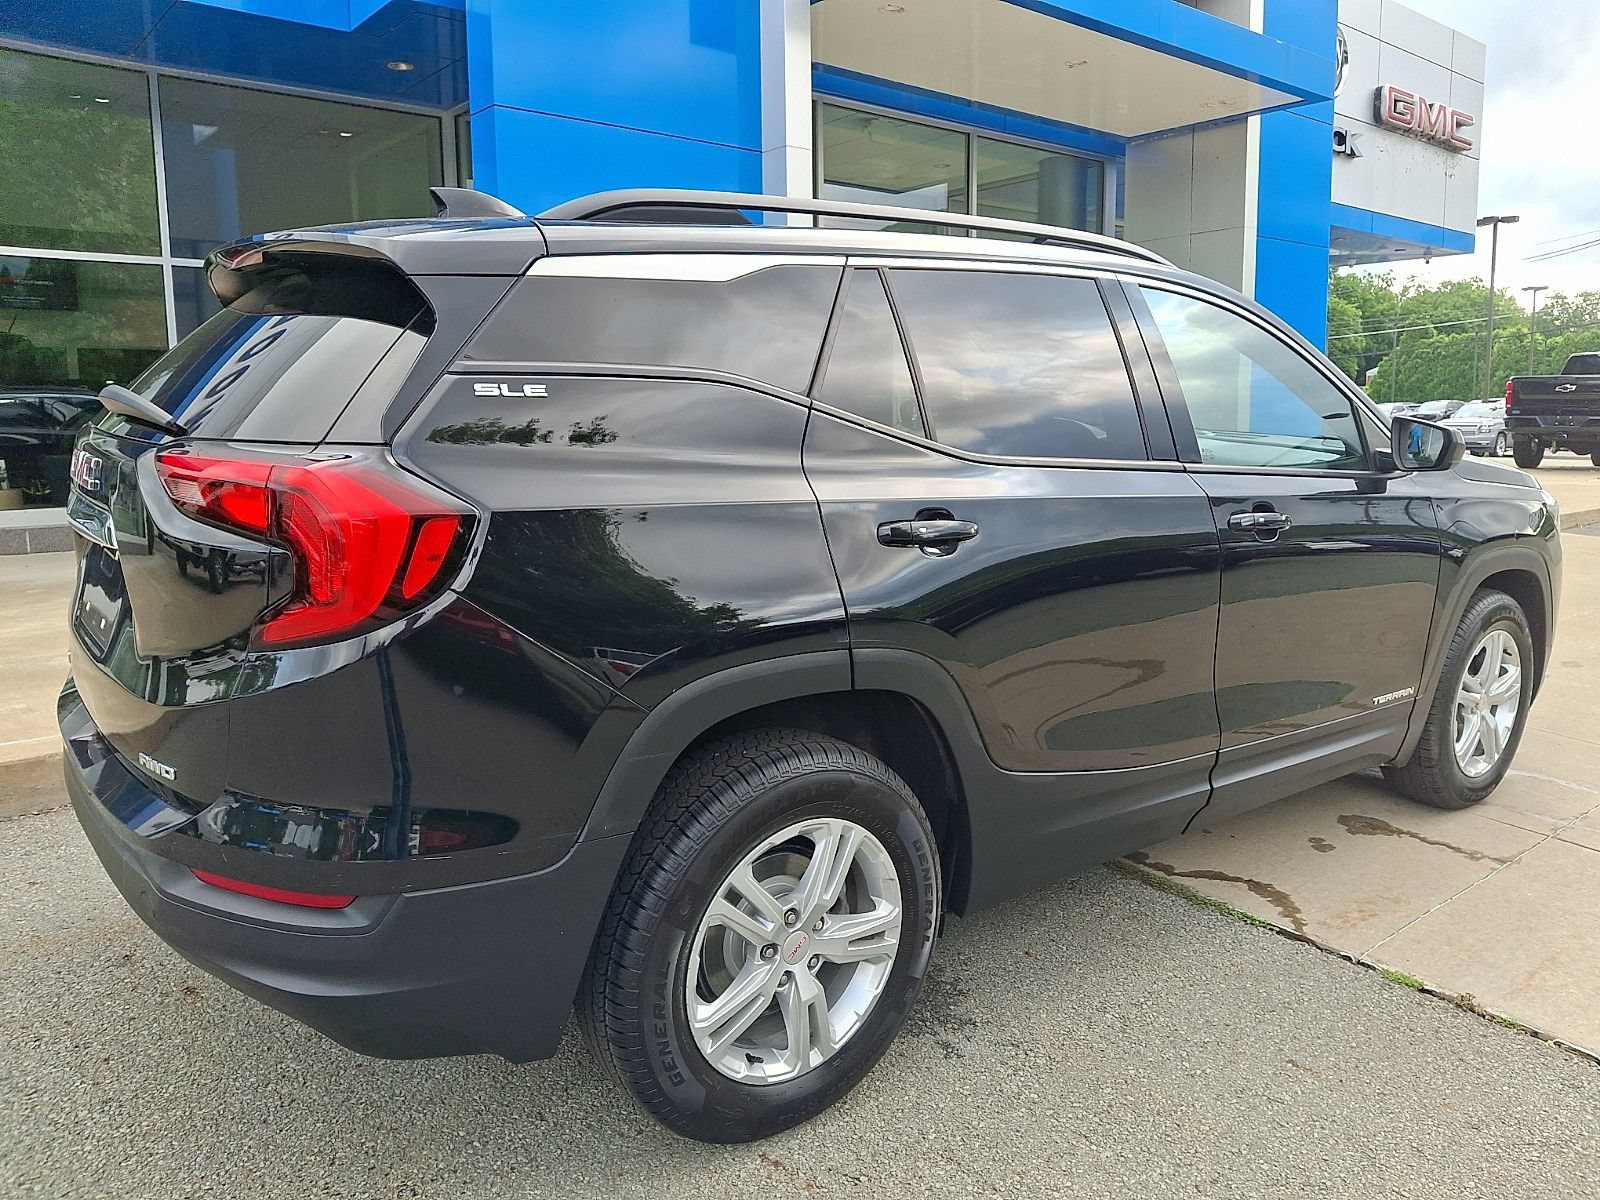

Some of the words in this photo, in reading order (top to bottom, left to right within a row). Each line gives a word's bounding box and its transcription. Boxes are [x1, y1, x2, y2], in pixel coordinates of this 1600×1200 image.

[1384, 84, 1475, 149] GMC
[473, 382, 549, 397] SLE
[1372, 686, 1415, 705] TERRAIN
[138, 752, 177, 780] AWD
[912, 838, 934, 949] GENERAL
